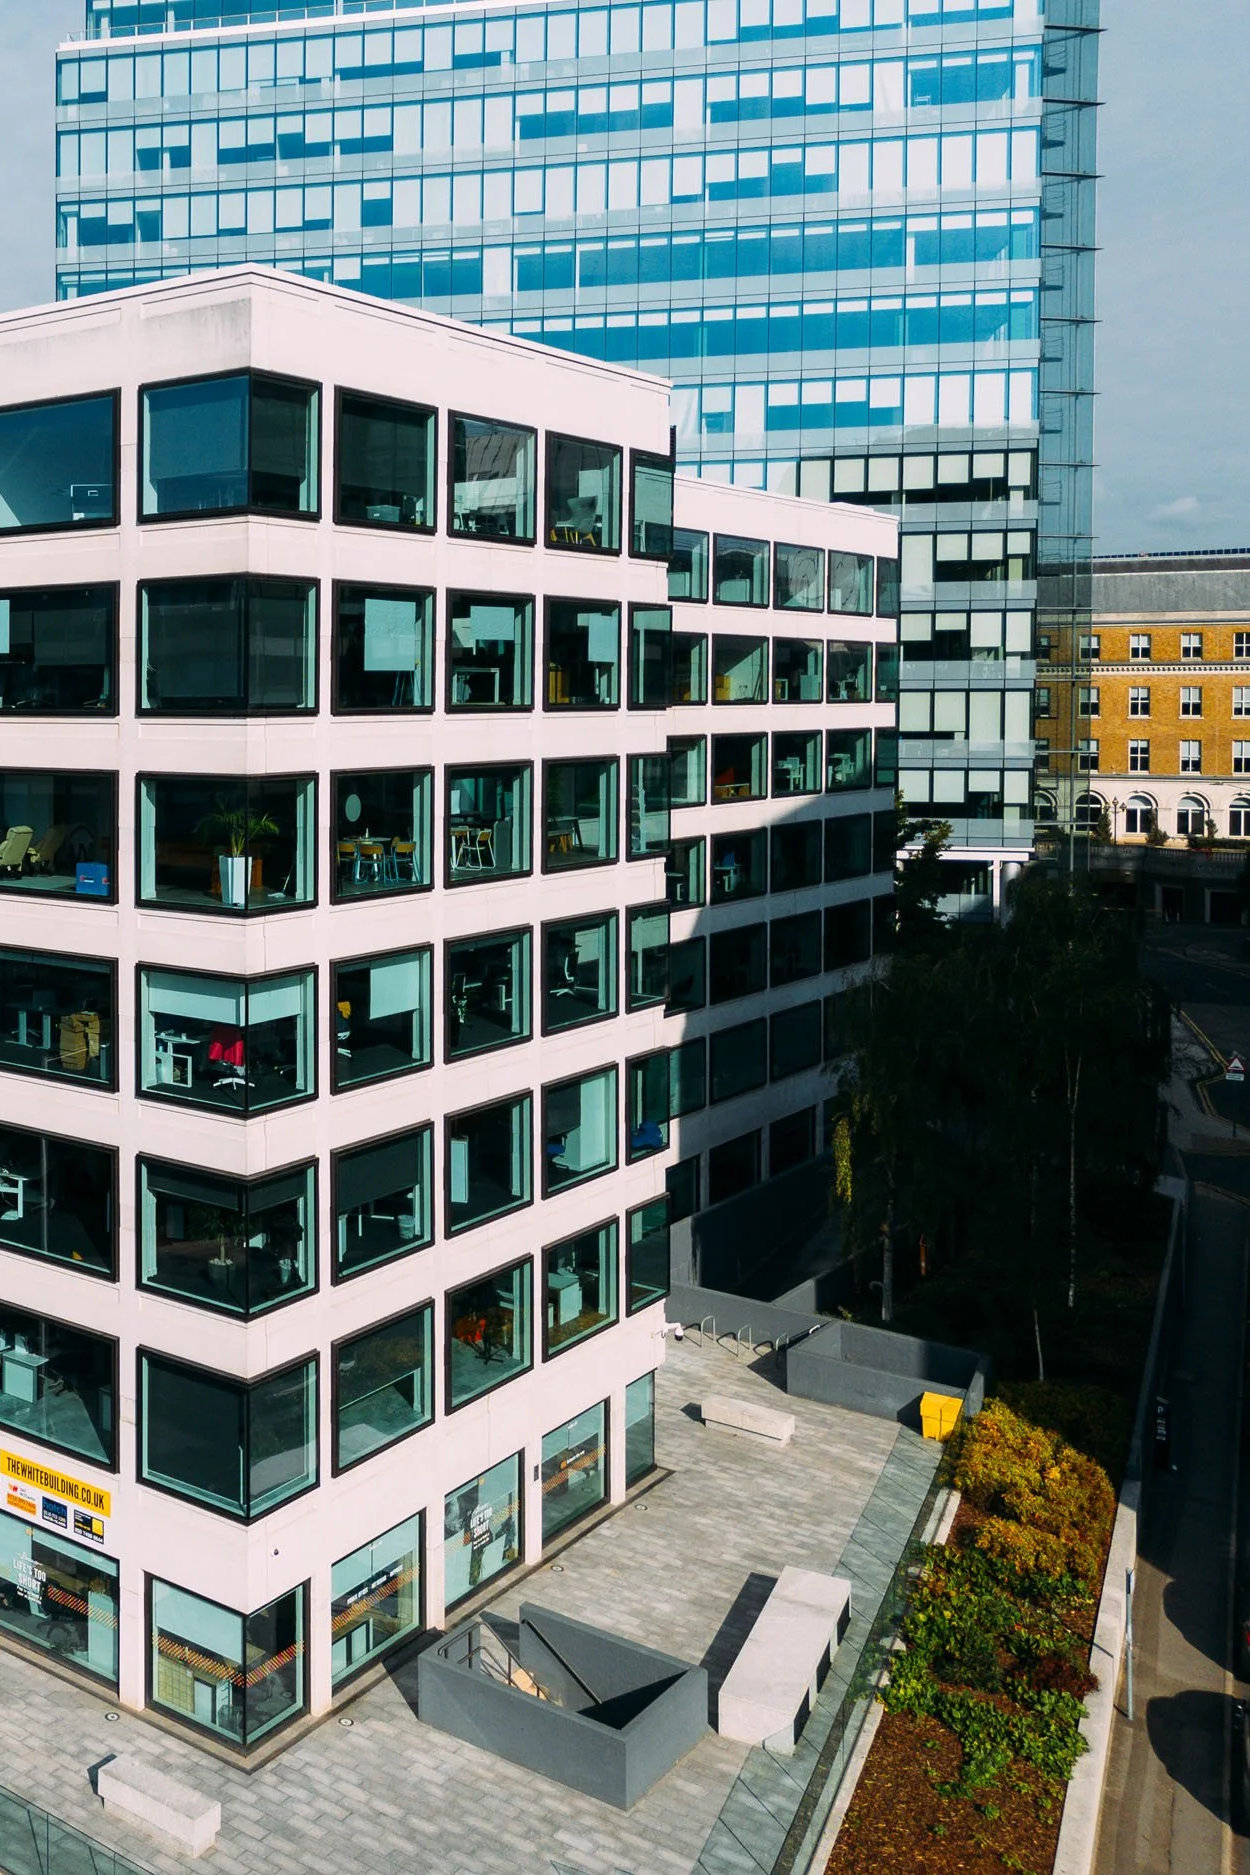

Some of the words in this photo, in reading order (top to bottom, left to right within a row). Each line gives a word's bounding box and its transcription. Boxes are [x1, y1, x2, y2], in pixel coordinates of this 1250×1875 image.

[6, 1456, 105, 1510] THEWHITEBUILDING.CO.UK
[13, 1557, 33, 1575] LIFE'S
[34, 1567, 47, 1582] TOO
[18, 1572, 41, 1593] SHORT
